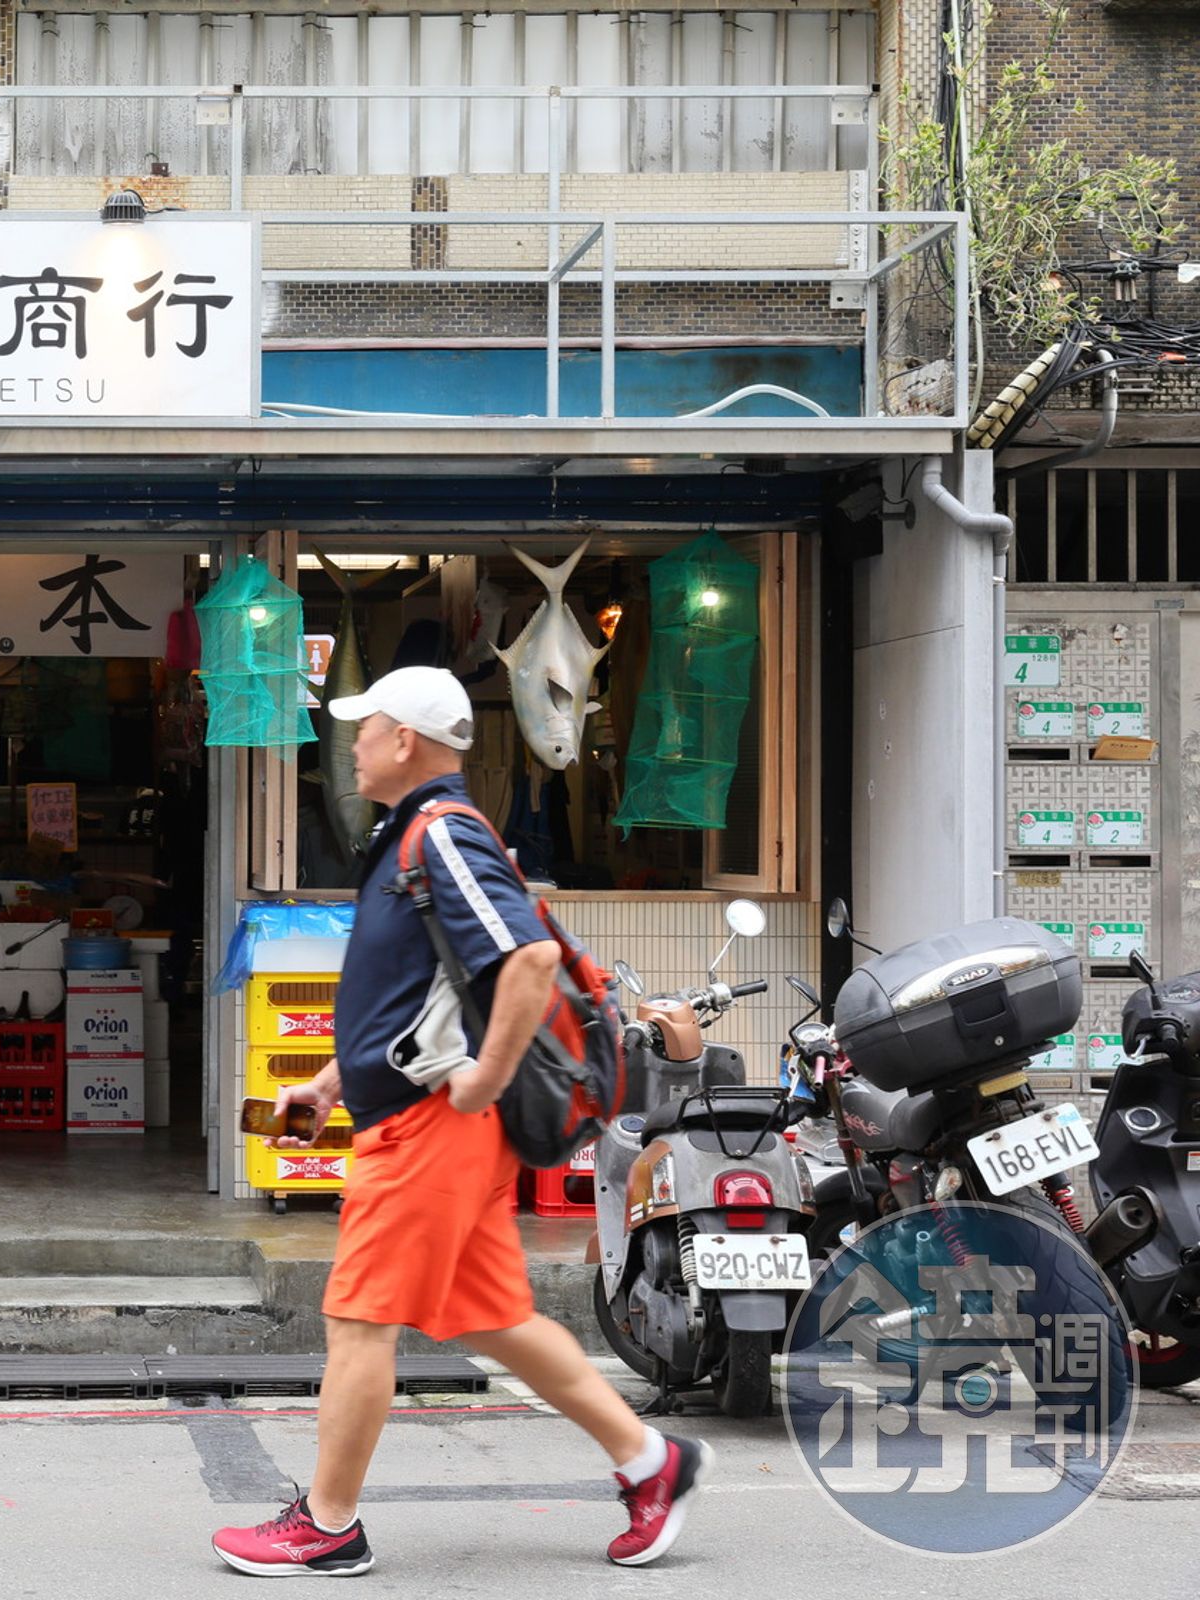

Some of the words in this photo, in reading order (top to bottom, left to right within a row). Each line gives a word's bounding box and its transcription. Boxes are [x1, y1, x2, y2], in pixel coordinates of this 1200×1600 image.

[1014, 662, 1029, 683] 4
[1042, 720, 1051, 734] 4
[1110, 720, 1121, 735] 2
[1042, 829, 1052, 844] 4
[1110, 829, 1120, 844] 2
[1112, 942, 1122, 955] 2
[951, 967, 990, 986] SHAD
[84, 1016, 129, 1033] Orion
[1043, 1053, 1052, 1066] 4
[1112, 1053, 1121, 1067] 2
[84, 1083, 129, 1101] Orion
